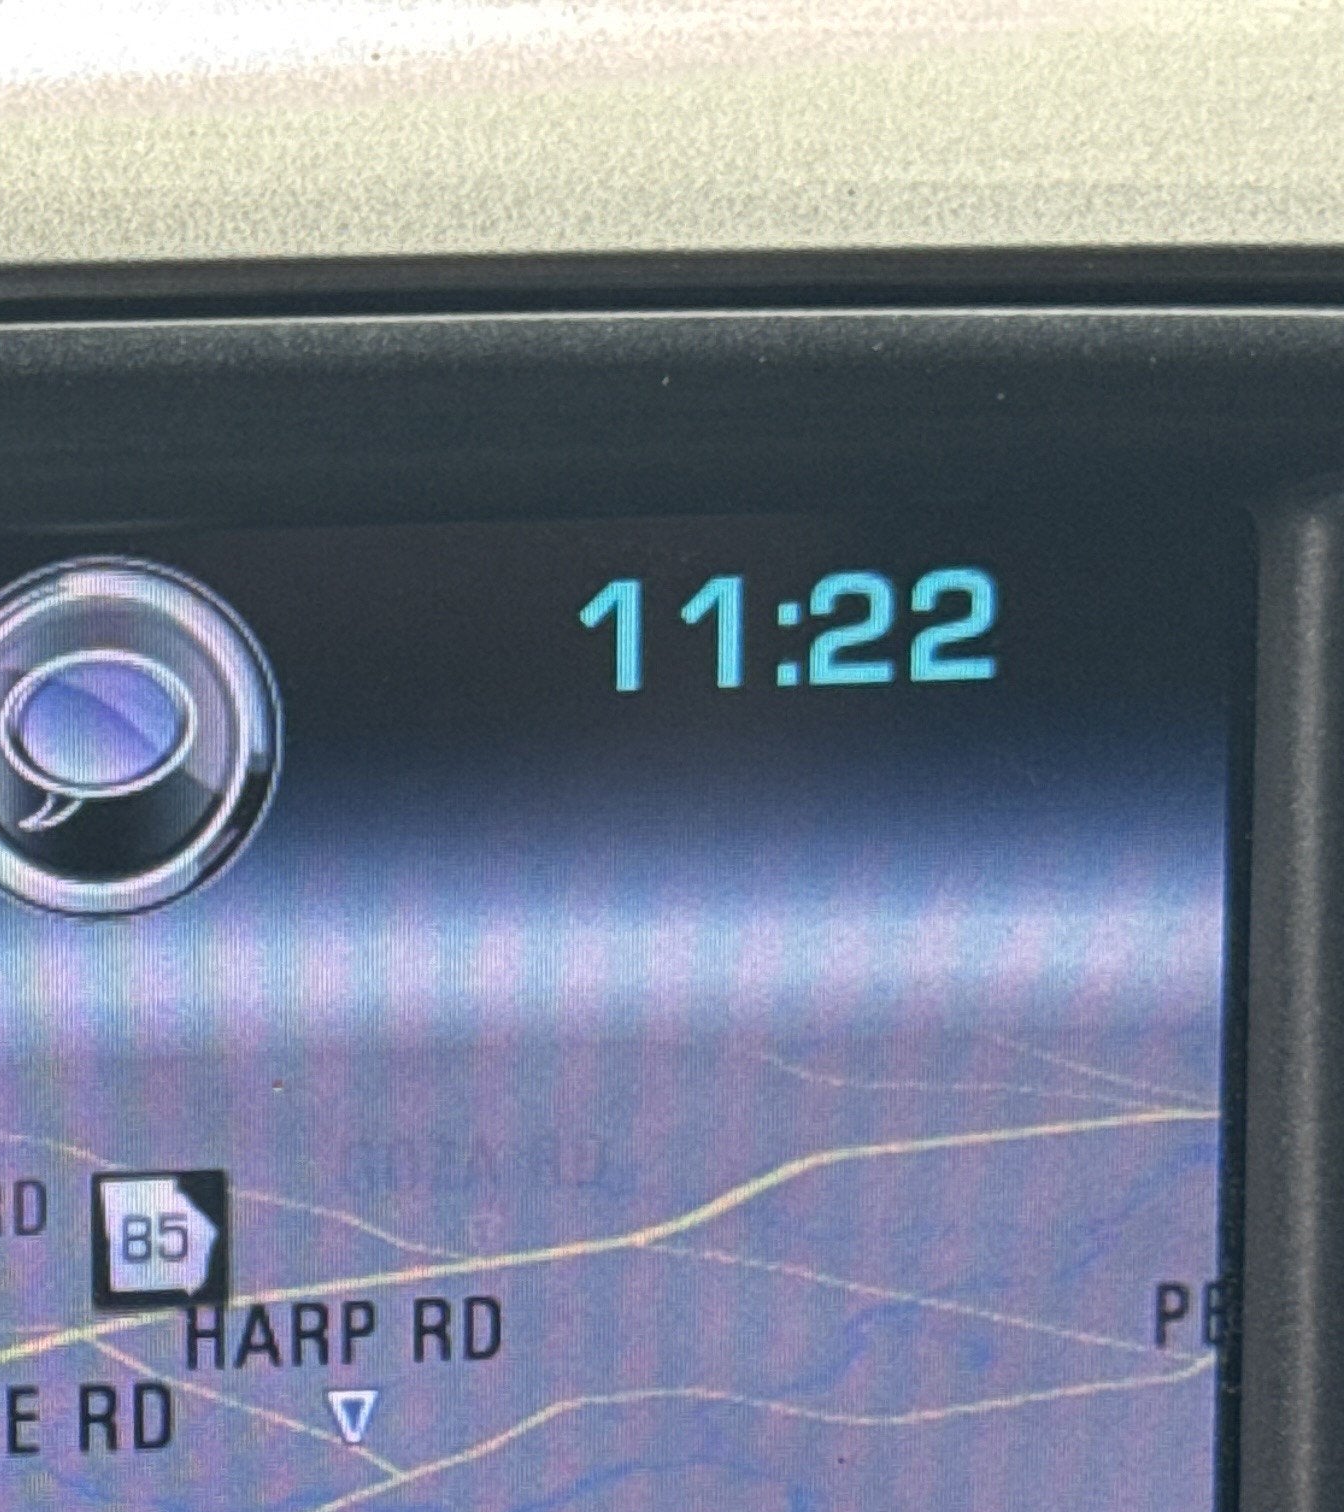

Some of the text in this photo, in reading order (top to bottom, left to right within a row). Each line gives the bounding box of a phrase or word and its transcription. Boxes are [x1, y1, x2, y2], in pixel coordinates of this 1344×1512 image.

[579, 567, 997, 692] 11:22
[122, 1213, 190, 1265] 85
[185, 1295, 504, 1371] HARP RD
[78, 1382, 175, 1453] RD
